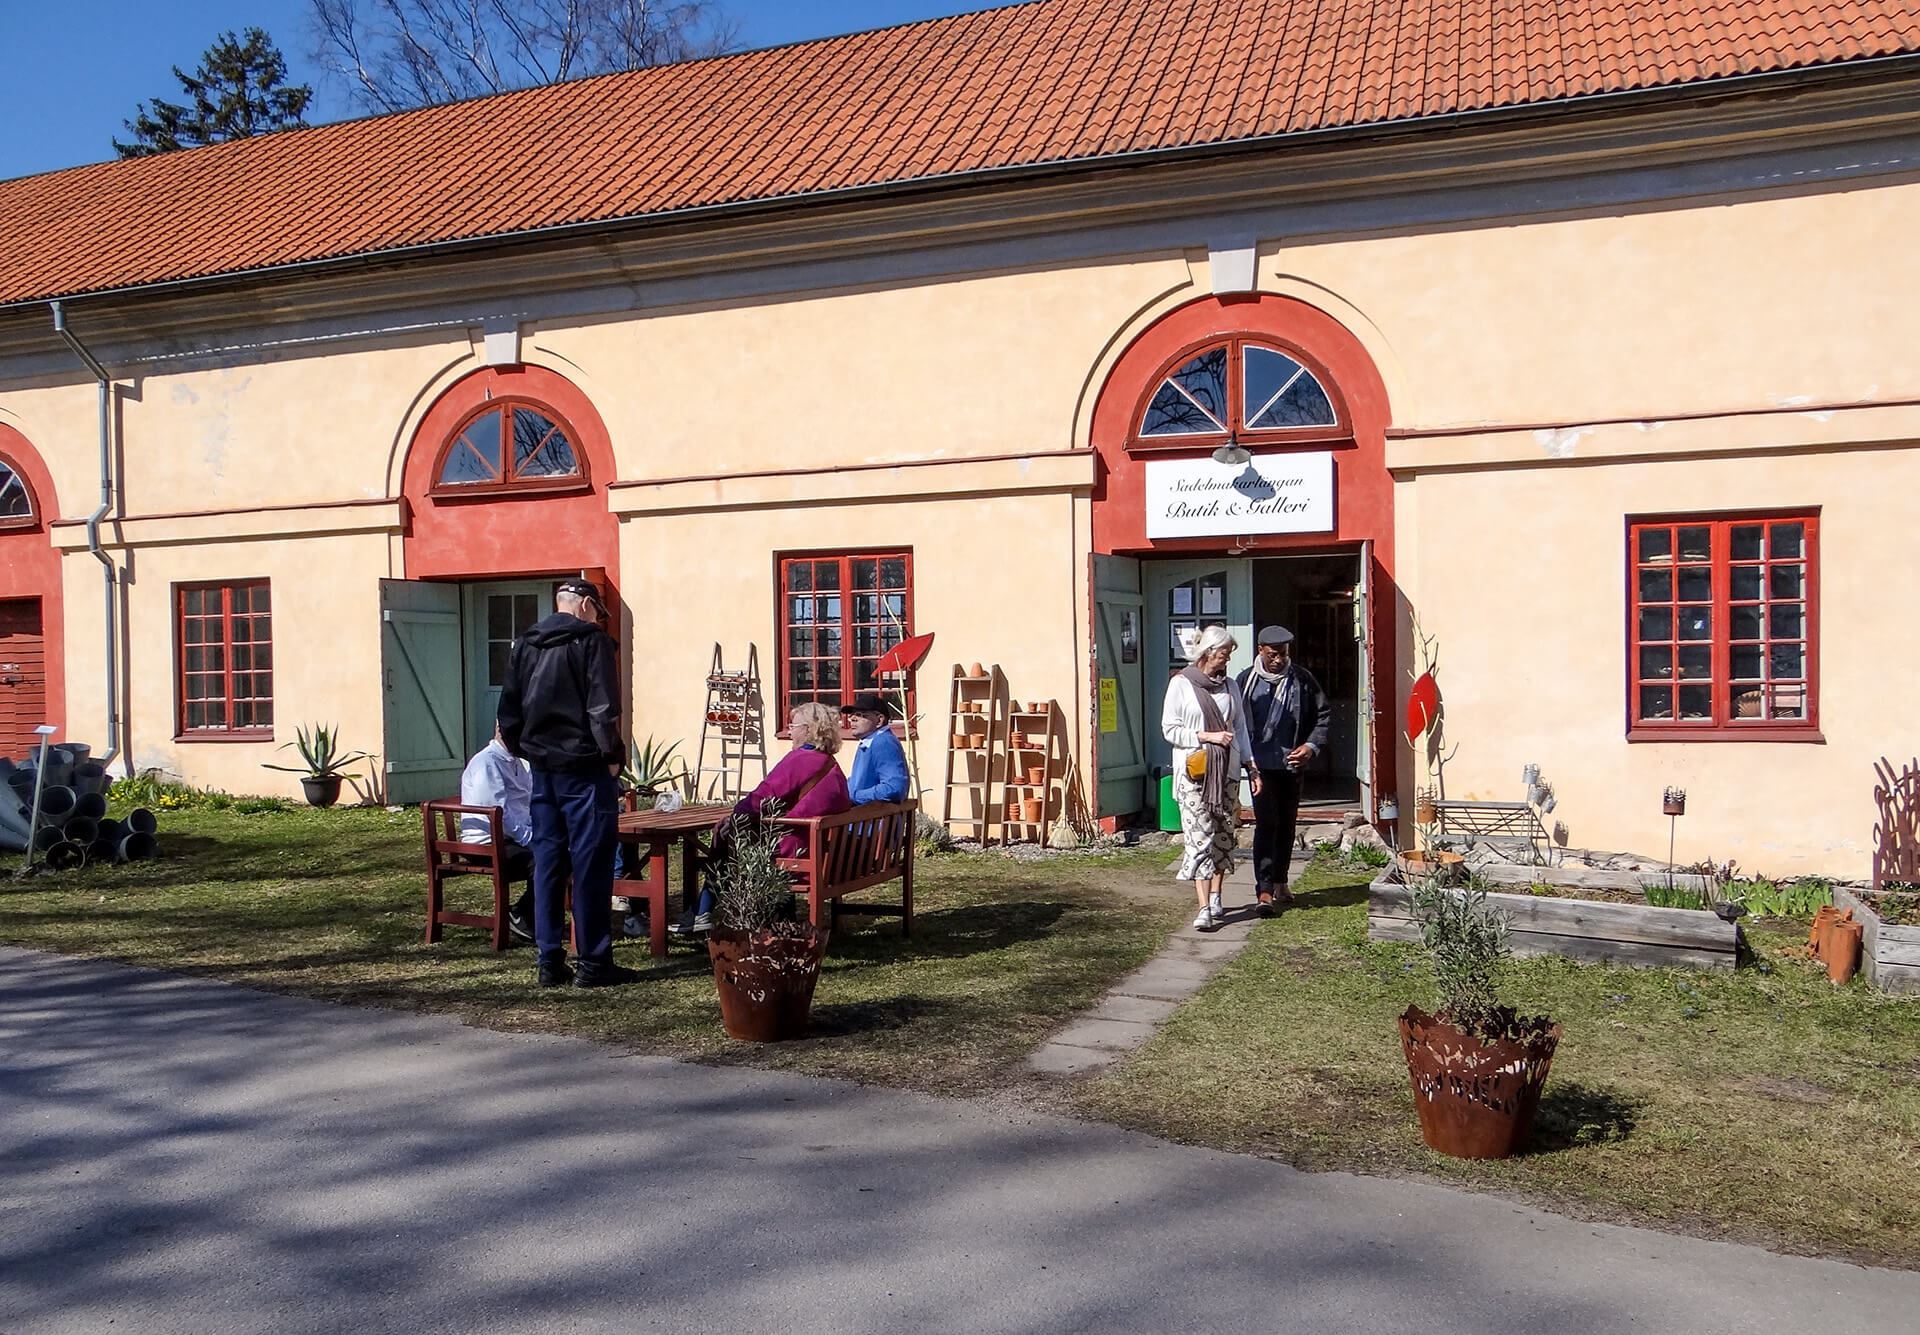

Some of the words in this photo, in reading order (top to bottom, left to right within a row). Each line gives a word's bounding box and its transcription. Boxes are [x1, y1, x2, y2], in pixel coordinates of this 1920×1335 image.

[1169, 475, 1304, 493] Sadelmakarlängan
[1165, 500, 1220, 519] Butik
[1225, 502, 1242, 516] &
[1246, 497, 1311, 515] Galleri
